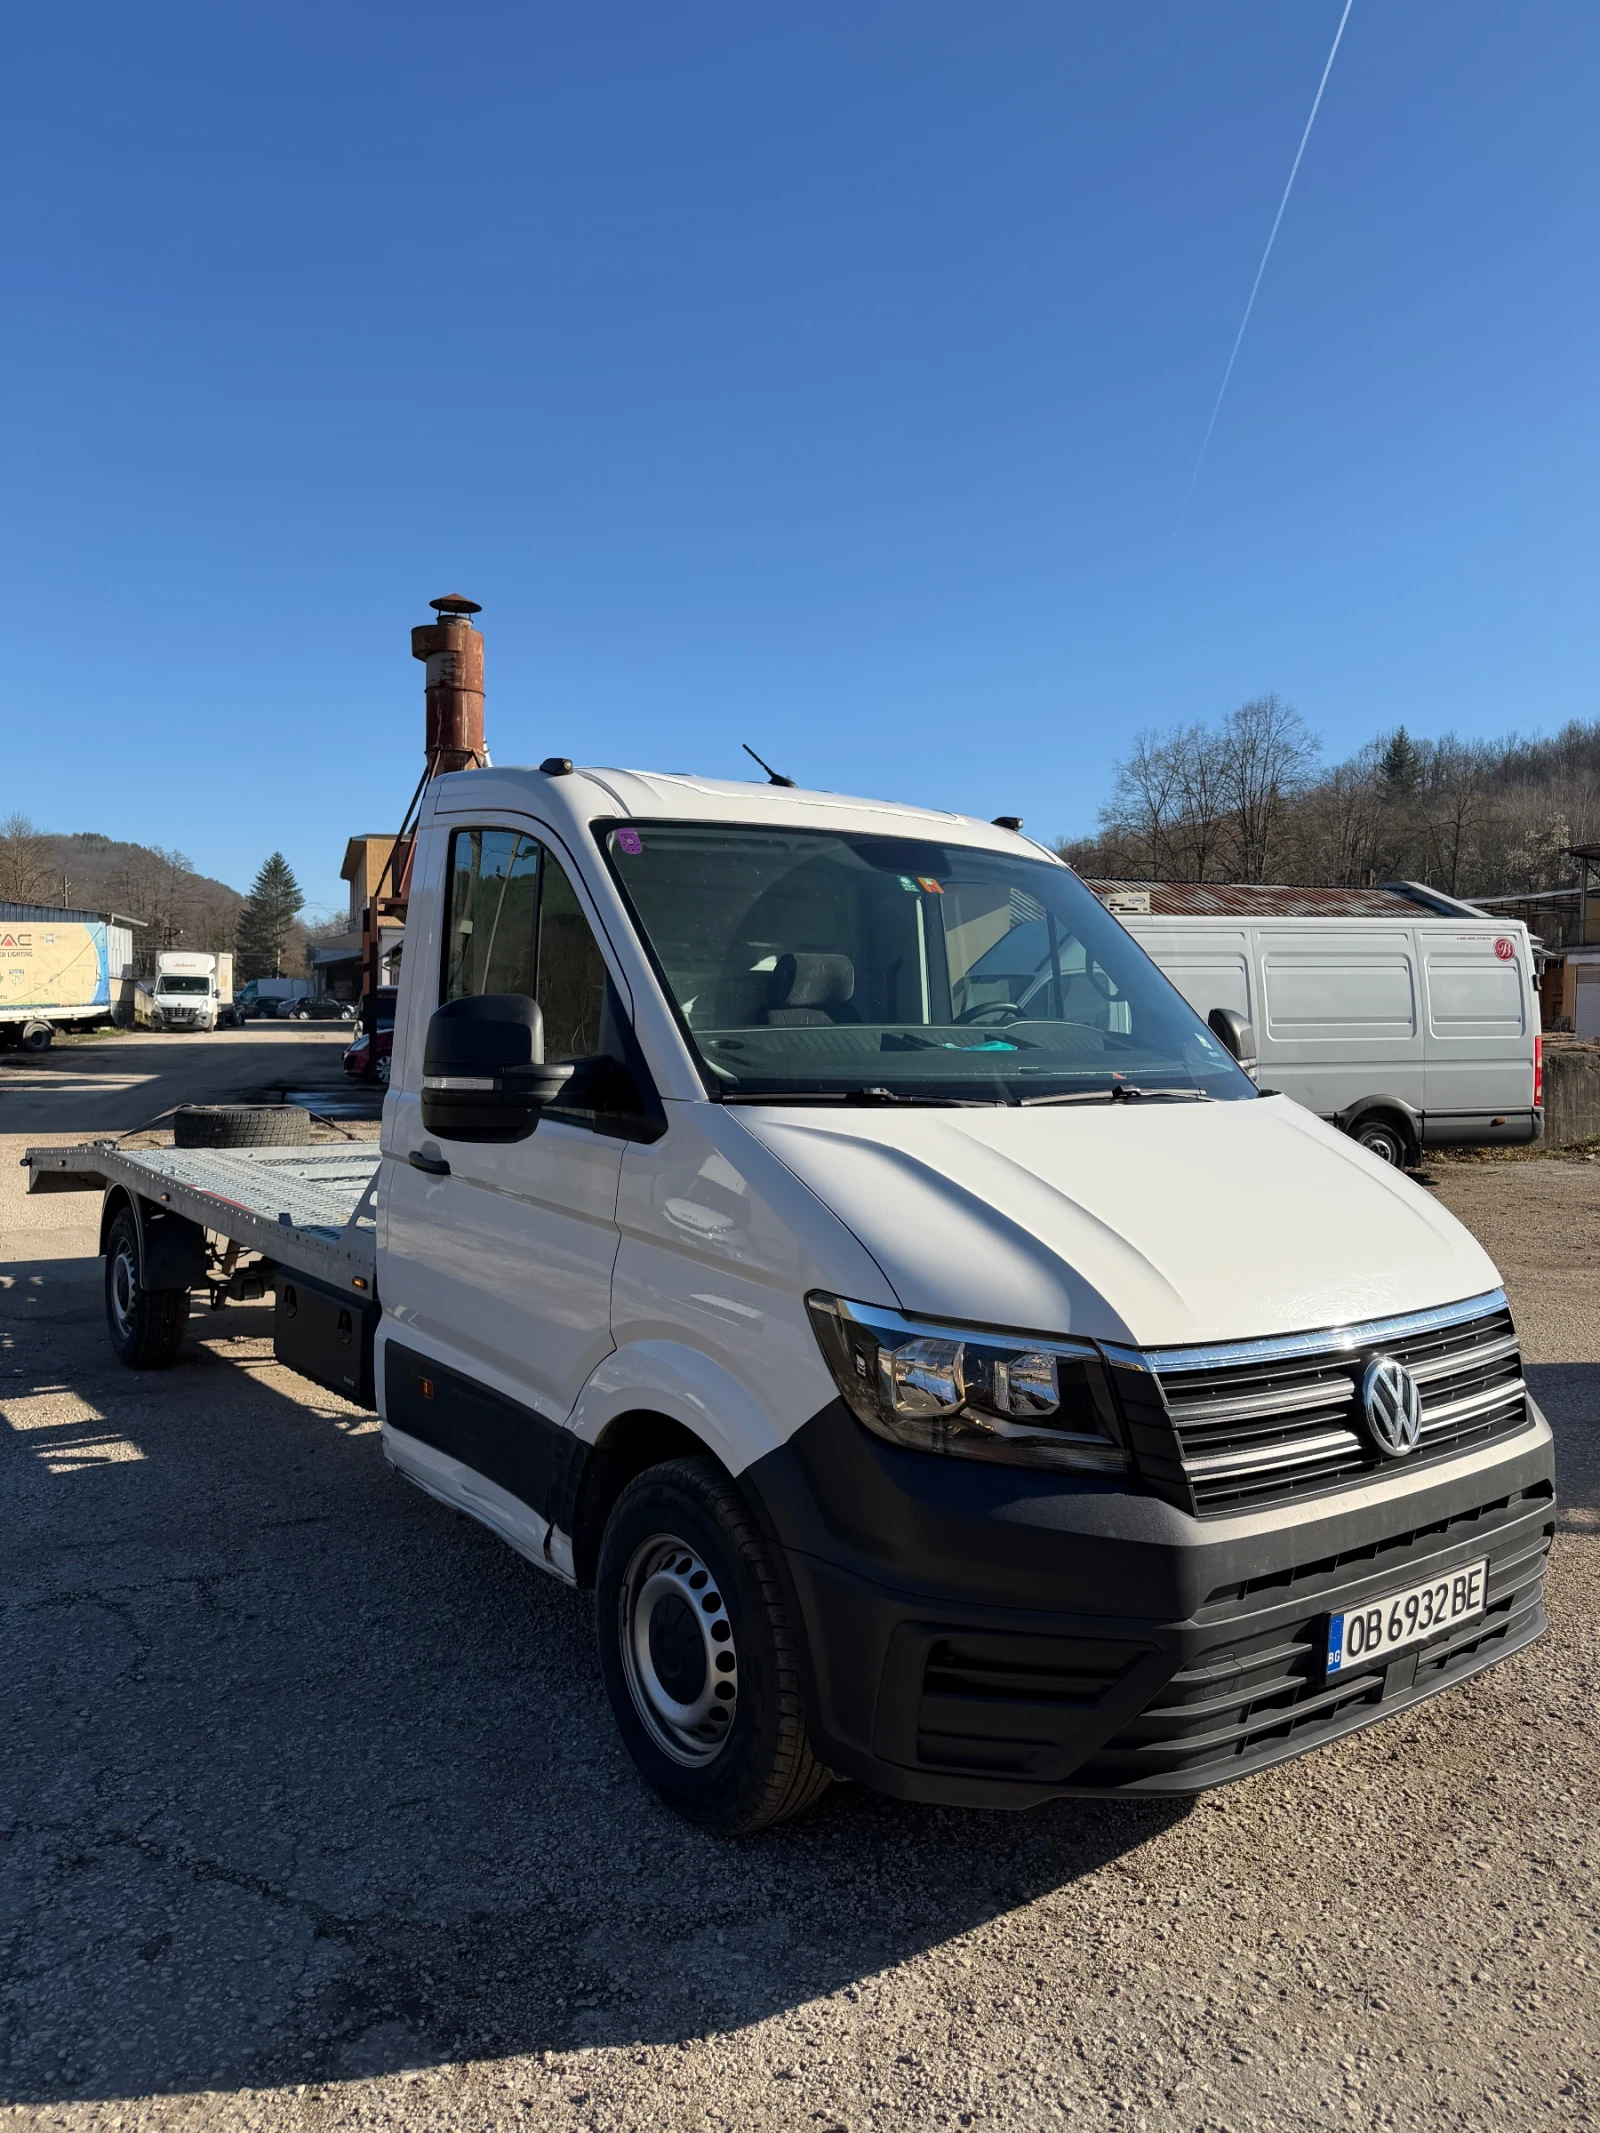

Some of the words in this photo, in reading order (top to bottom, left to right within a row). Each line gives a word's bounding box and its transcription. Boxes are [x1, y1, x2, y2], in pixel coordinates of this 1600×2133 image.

[0, 933, 32, 946] AC
[1387, 1582, 1449, 1643] 6932
[1451, 1567, 1483, 1618] BE
[1327, 1650, 1341, 1666] BG
